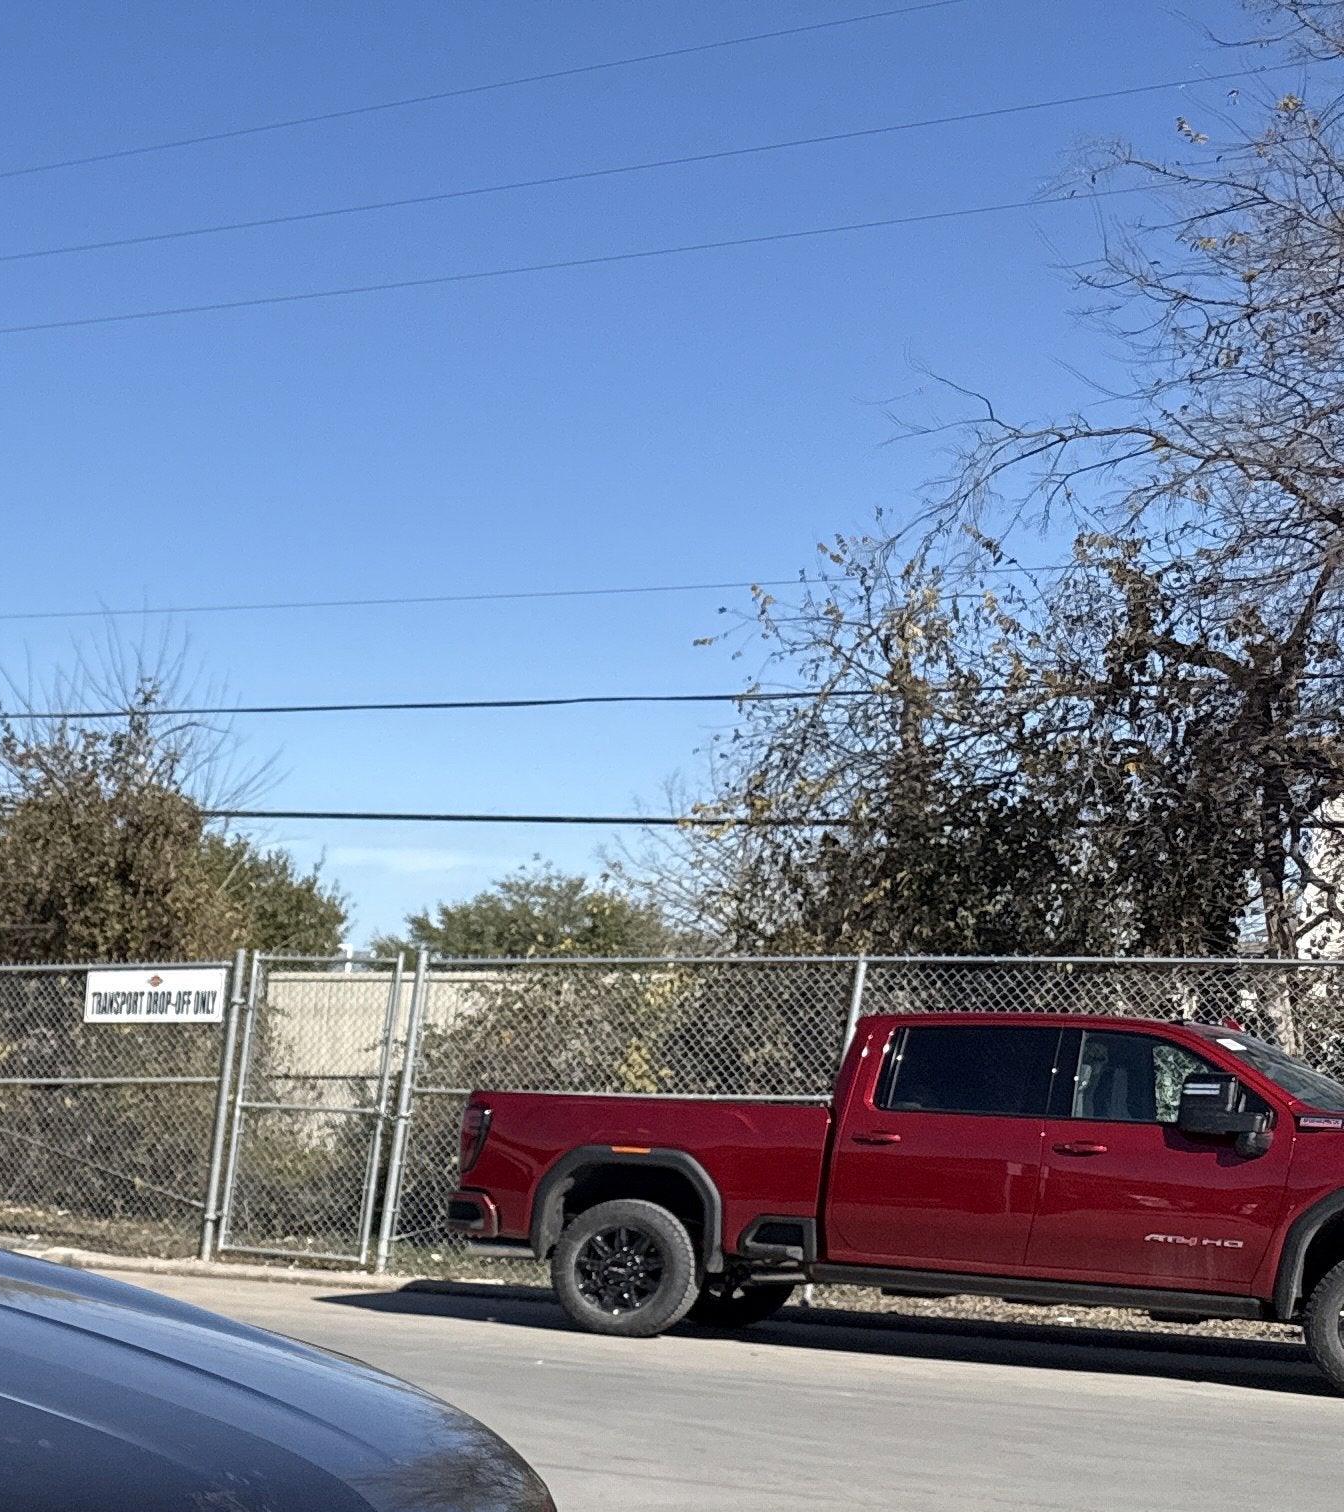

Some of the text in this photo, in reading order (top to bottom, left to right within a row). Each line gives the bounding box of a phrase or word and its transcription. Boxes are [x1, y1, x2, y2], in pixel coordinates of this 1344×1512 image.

[91, 990, 218, 1016] TRANSPORT DROP-OFF ONLY
[1144, 1233, 1244, 1249] AT4 HD
